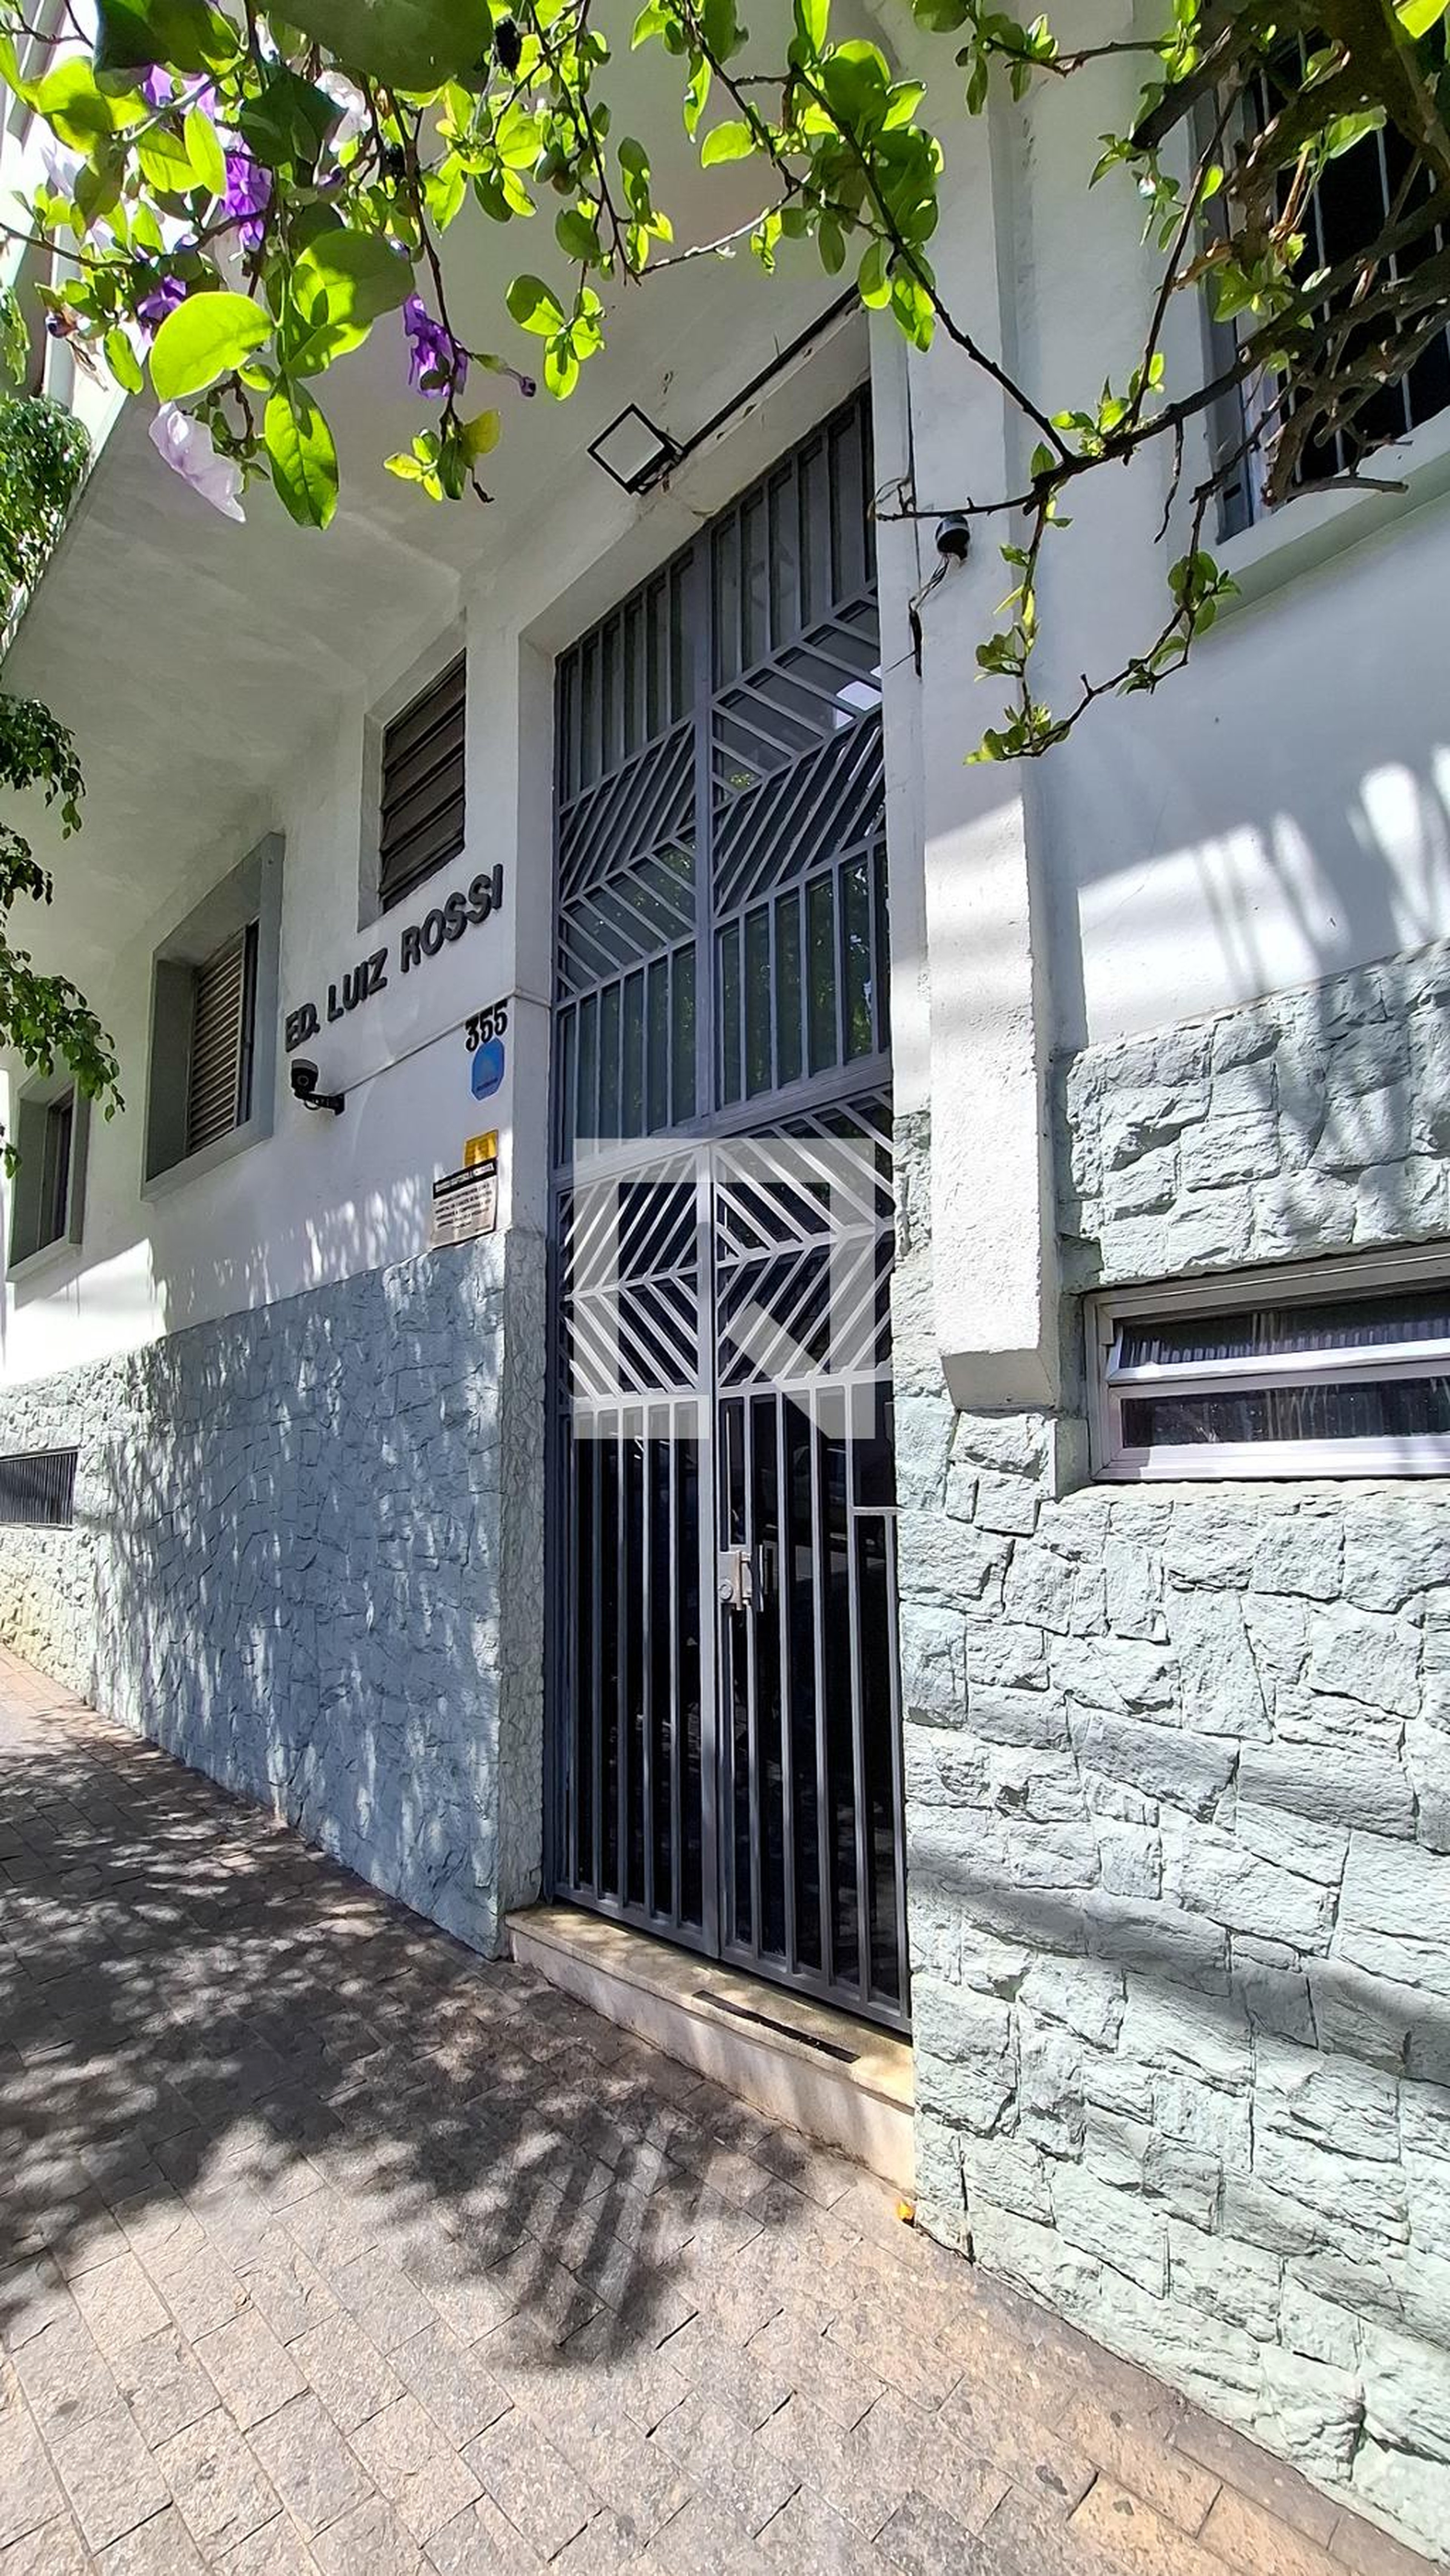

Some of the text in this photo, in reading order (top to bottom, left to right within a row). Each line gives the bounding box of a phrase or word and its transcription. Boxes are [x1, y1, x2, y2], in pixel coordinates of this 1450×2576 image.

[286, 864, 503, 1053] ED. LUIZ ROSSI
[465, 999, 508, 1052] 355
